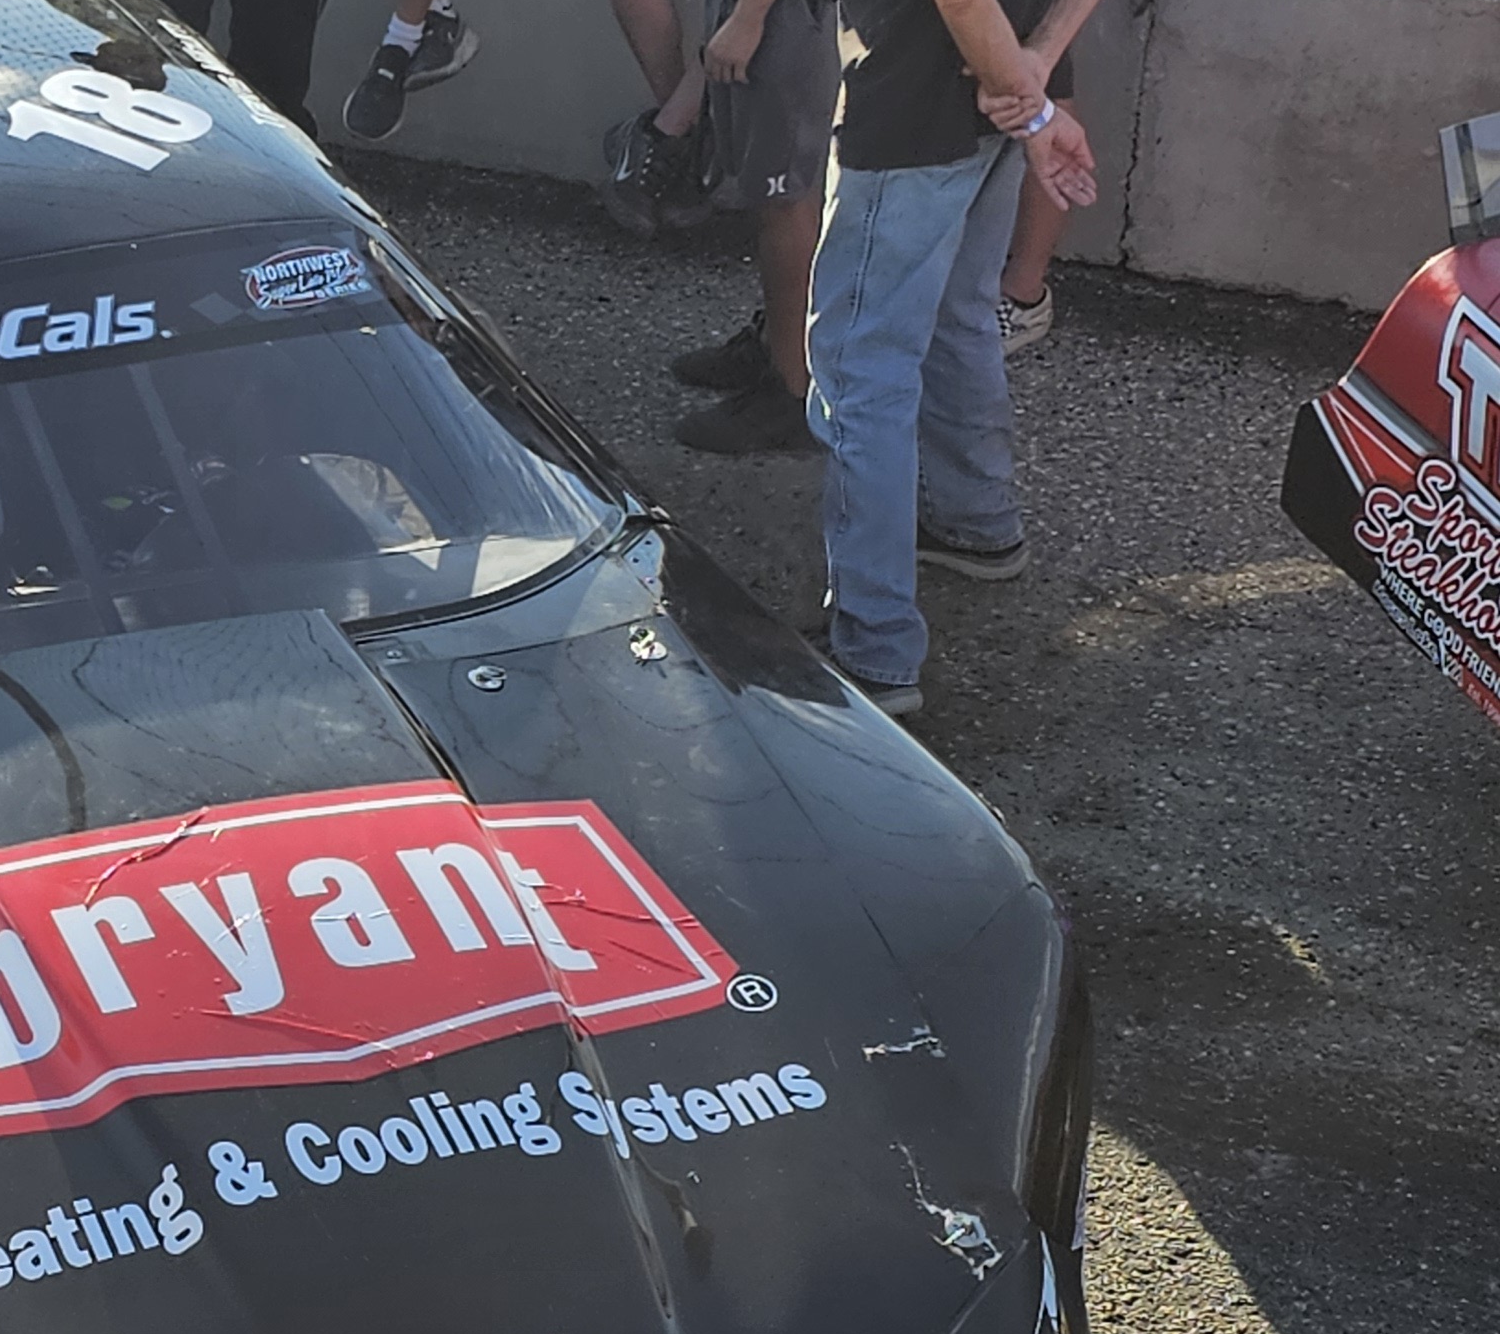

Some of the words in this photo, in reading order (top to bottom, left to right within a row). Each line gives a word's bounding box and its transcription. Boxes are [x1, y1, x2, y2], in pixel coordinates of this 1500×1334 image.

[7, 69, 213, 171] 18
[240, 248, 351, 284] NORTHWEST
[1374, 556, 1426, 618] WHERE
[1423, 608, 1464, 654] GOOD
[208, 1140, 275, 1206] &
[284, 1080, 562, 1187] Cooling
[559, 1061, 828, 1160] Systems
